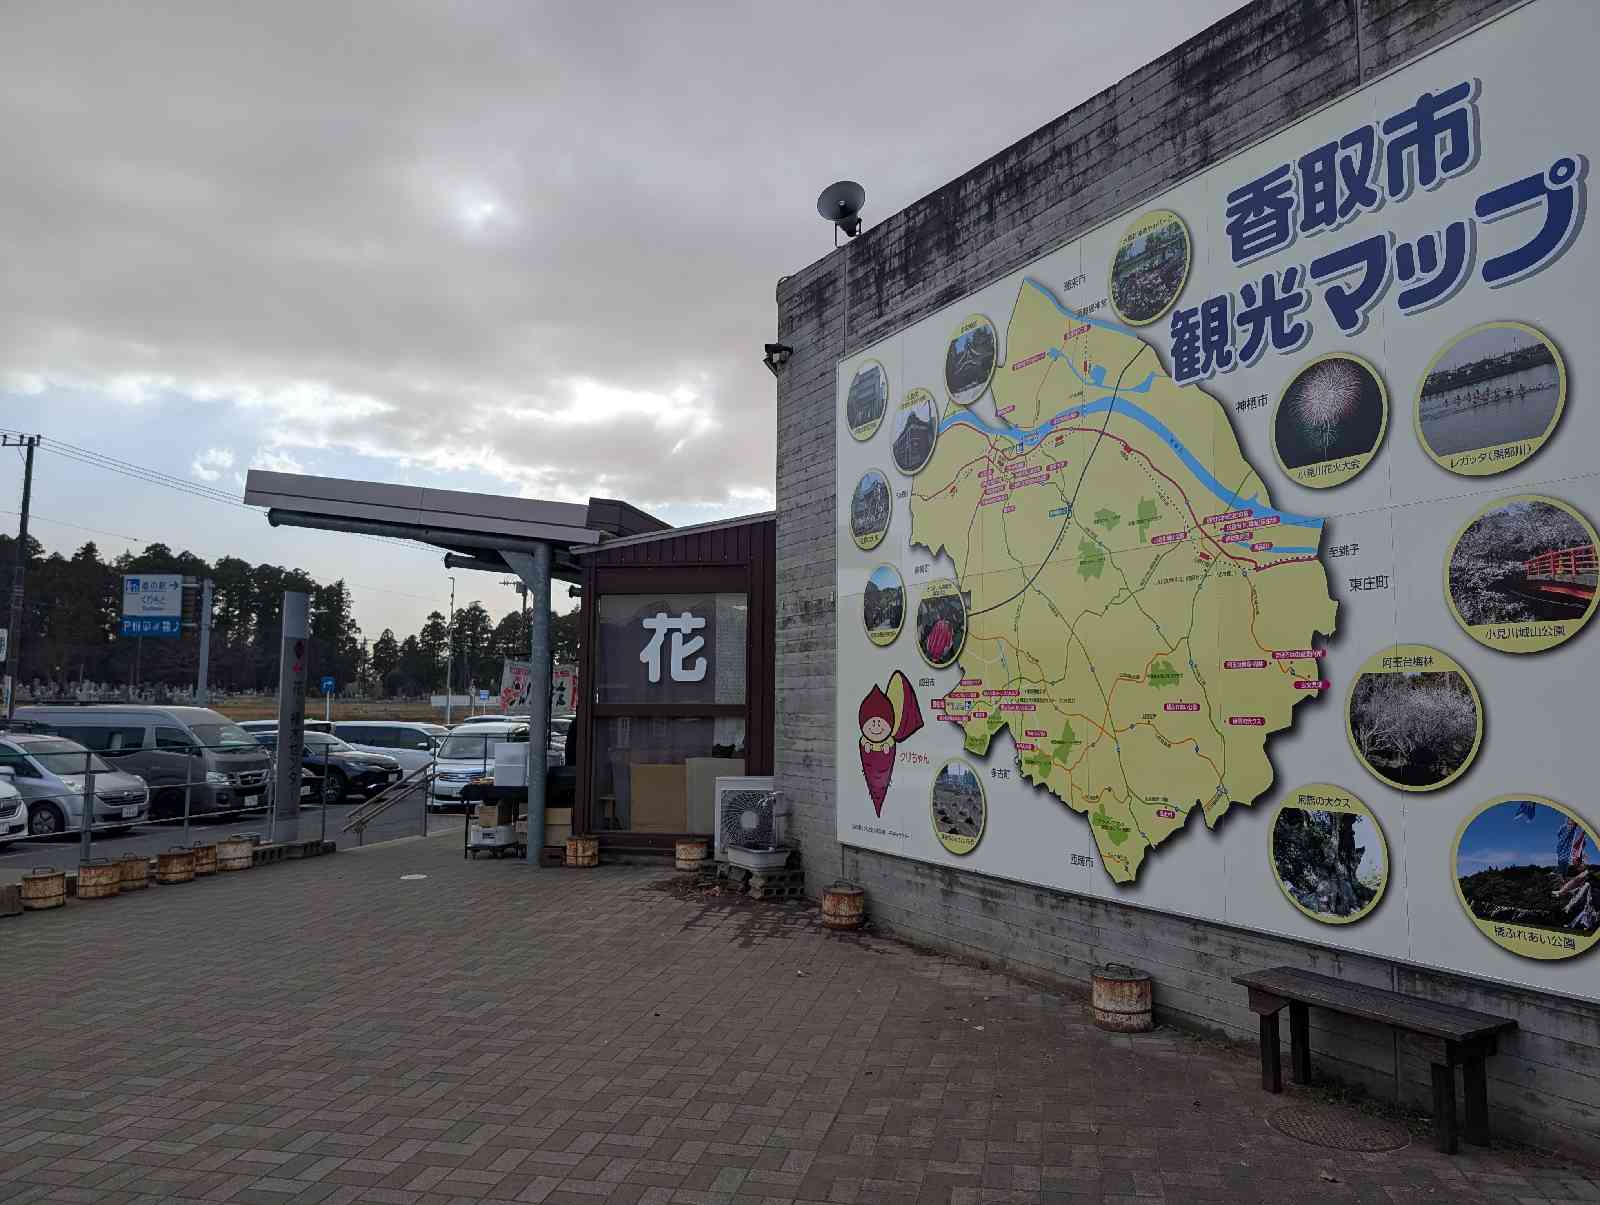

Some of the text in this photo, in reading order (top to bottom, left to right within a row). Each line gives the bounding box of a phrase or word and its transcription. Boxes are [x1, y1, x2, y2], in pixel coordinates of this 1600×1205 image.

[1225, 77, 1481, 264] 香取市
[1170, 154, 1588, 384] 観光マップ
[639, 611, 708, 683] 花
[1349, 575, 1389, 592] 東庄町
